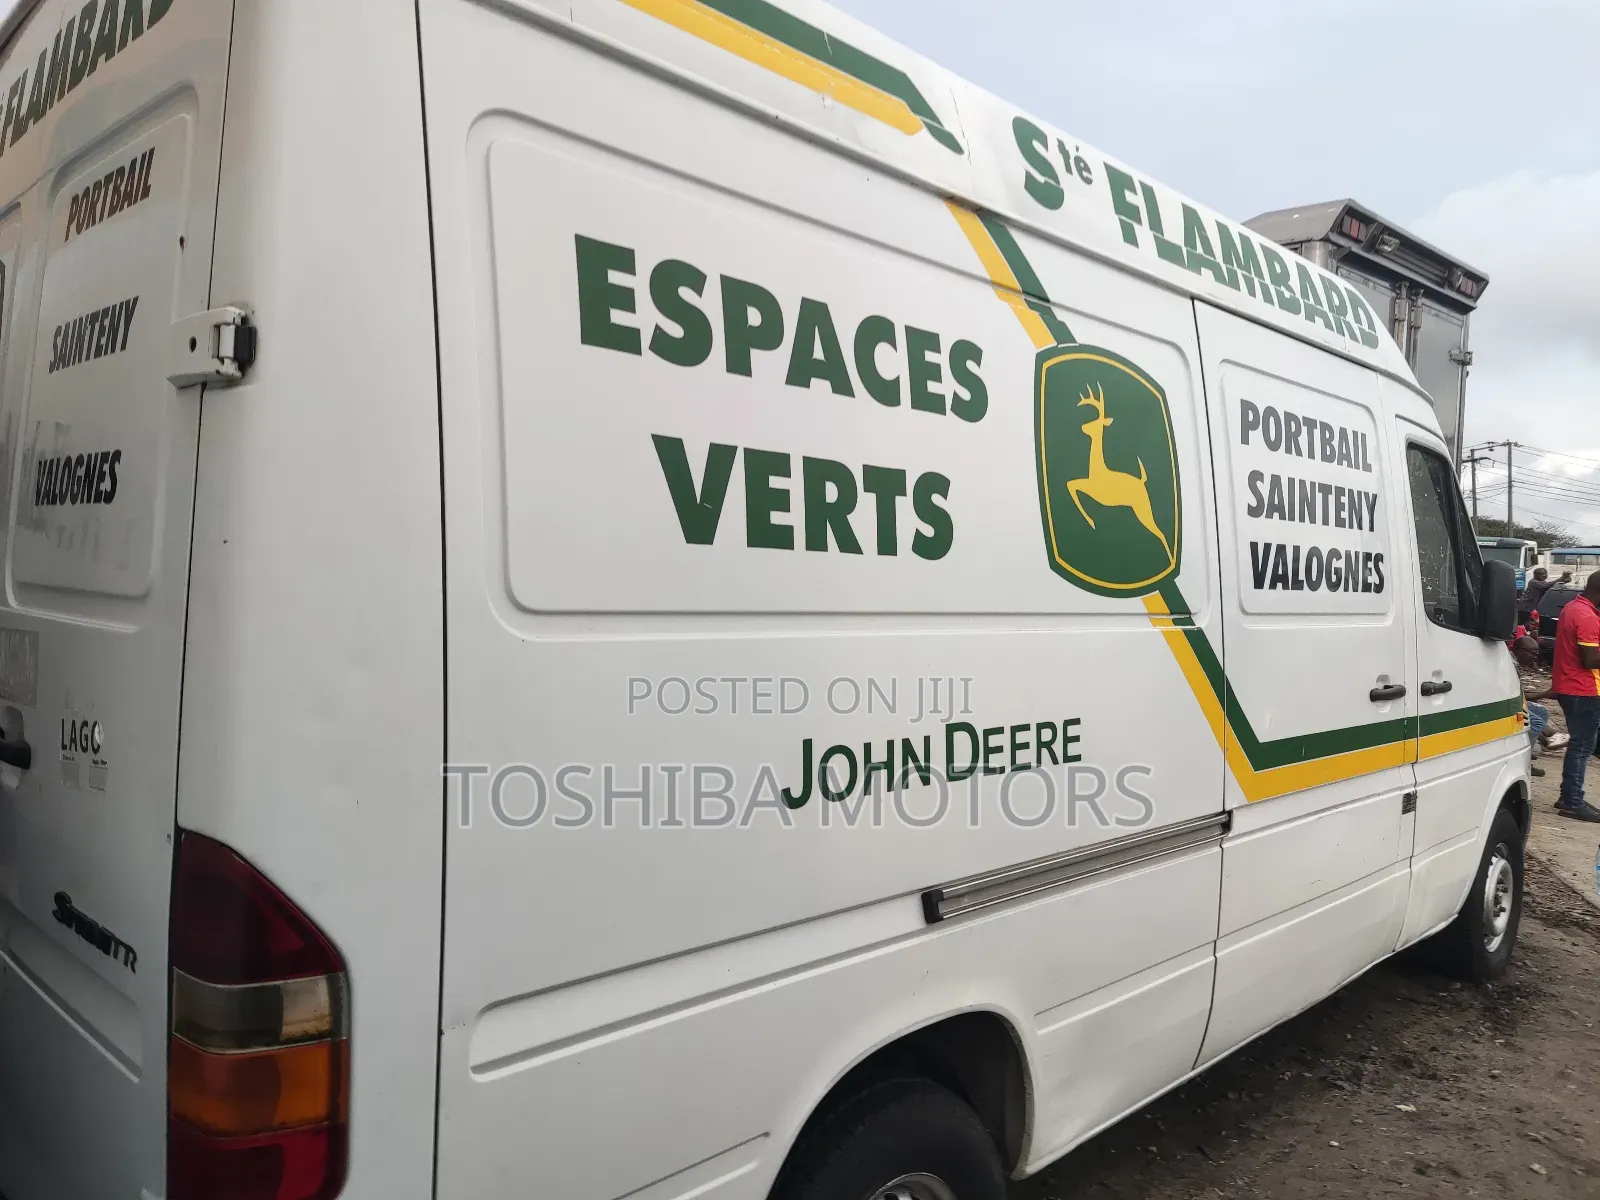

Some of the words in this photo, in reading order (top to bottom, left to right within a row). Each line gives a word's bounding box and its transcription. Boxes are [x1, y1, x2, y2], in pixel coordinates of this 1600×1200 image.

[64, 147, 155, 243] PORTBAIL
[1103, 161, 1379, 350] FLAMBARD
[49, 295, 139, 374] SAINTENY
[575, 233, 988, 423] ESPACES
[35, 449, 122, 507] VALOGNES
[1240, 398, 1372, 473] PORTBAIL
[651, 433, 954, 560] VERTS
[1247, 469, 1378, 532] SAINTENY
[1250, 541, 1385, 594] VALOGNES
[781, 735, 932, 810] JOHN
[944, 717, 1082, 783] DEERE
